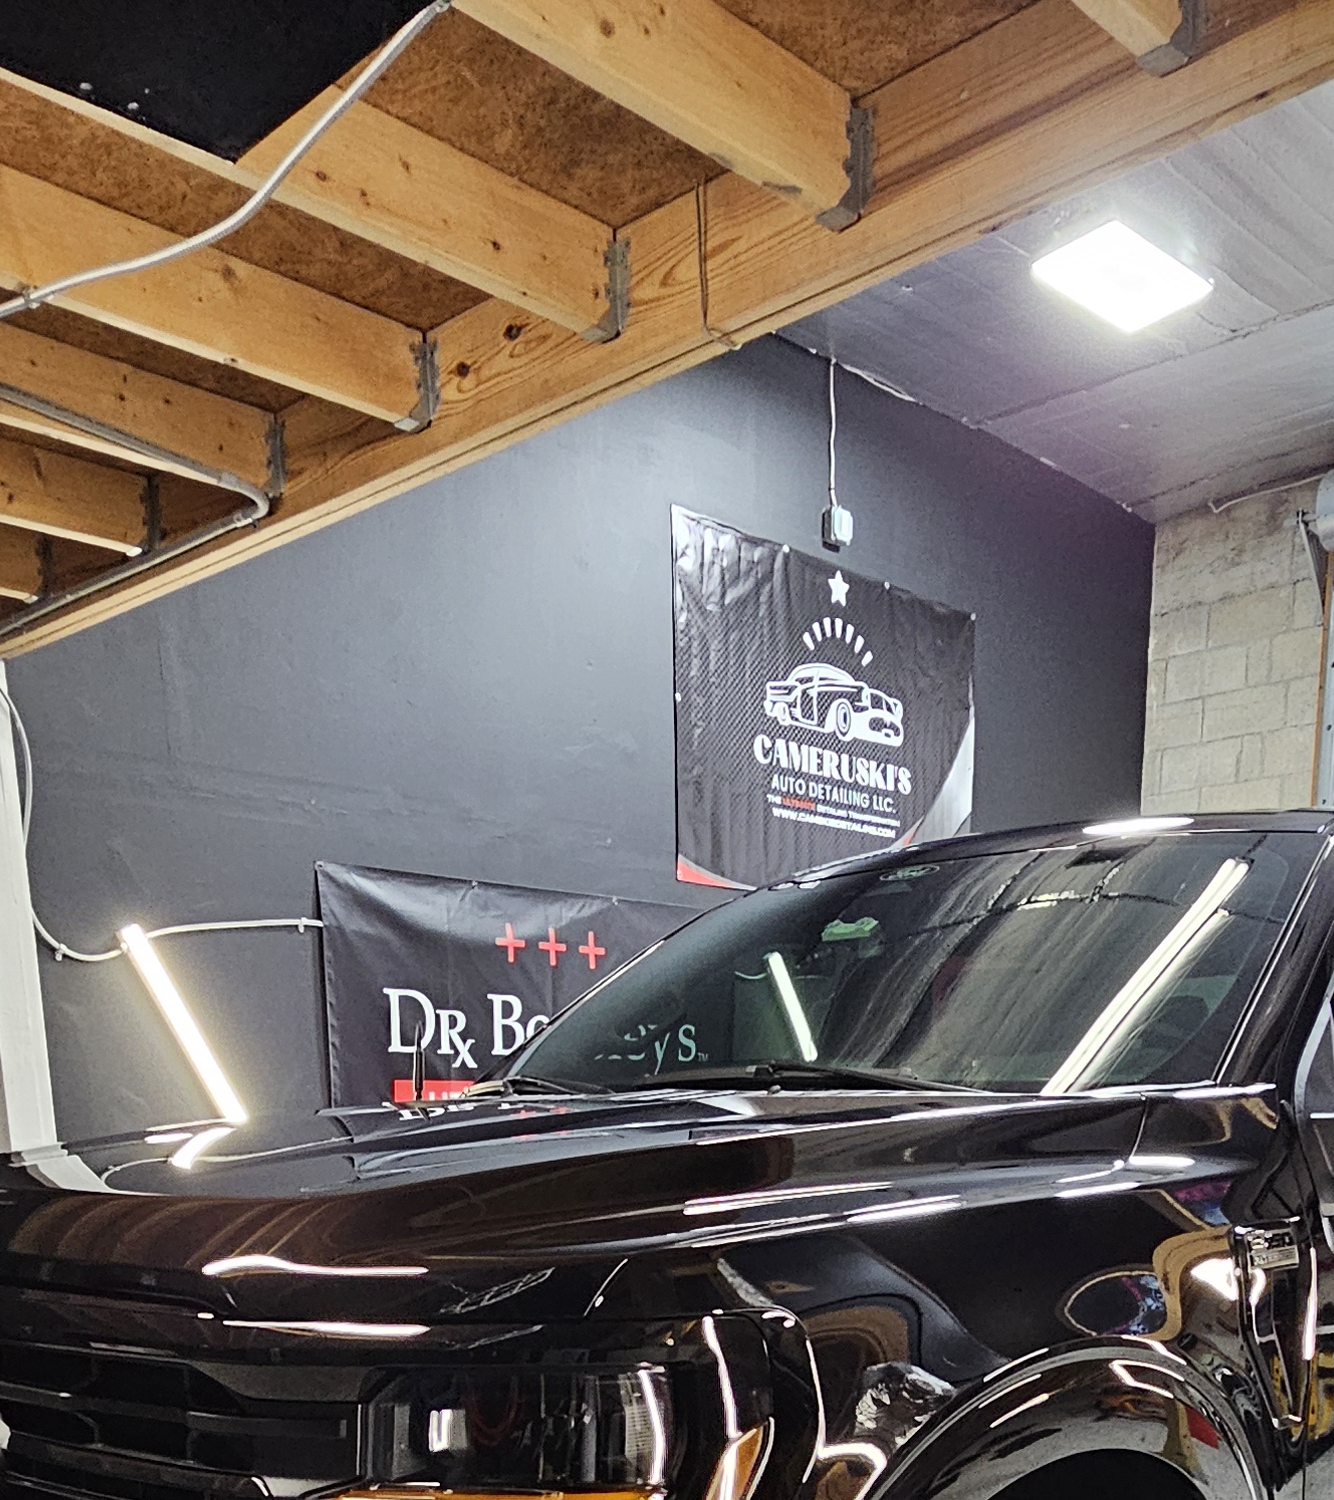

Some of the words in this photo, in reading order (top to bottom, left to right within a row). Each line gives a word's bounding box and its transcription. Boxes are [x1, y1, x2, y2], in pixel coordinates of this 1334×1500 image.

[753, 733, 912, 795] CAMERUSKI'S
[771, 773, 806, 795] AUTO
[808, 782, 870, 808] DETAILING
